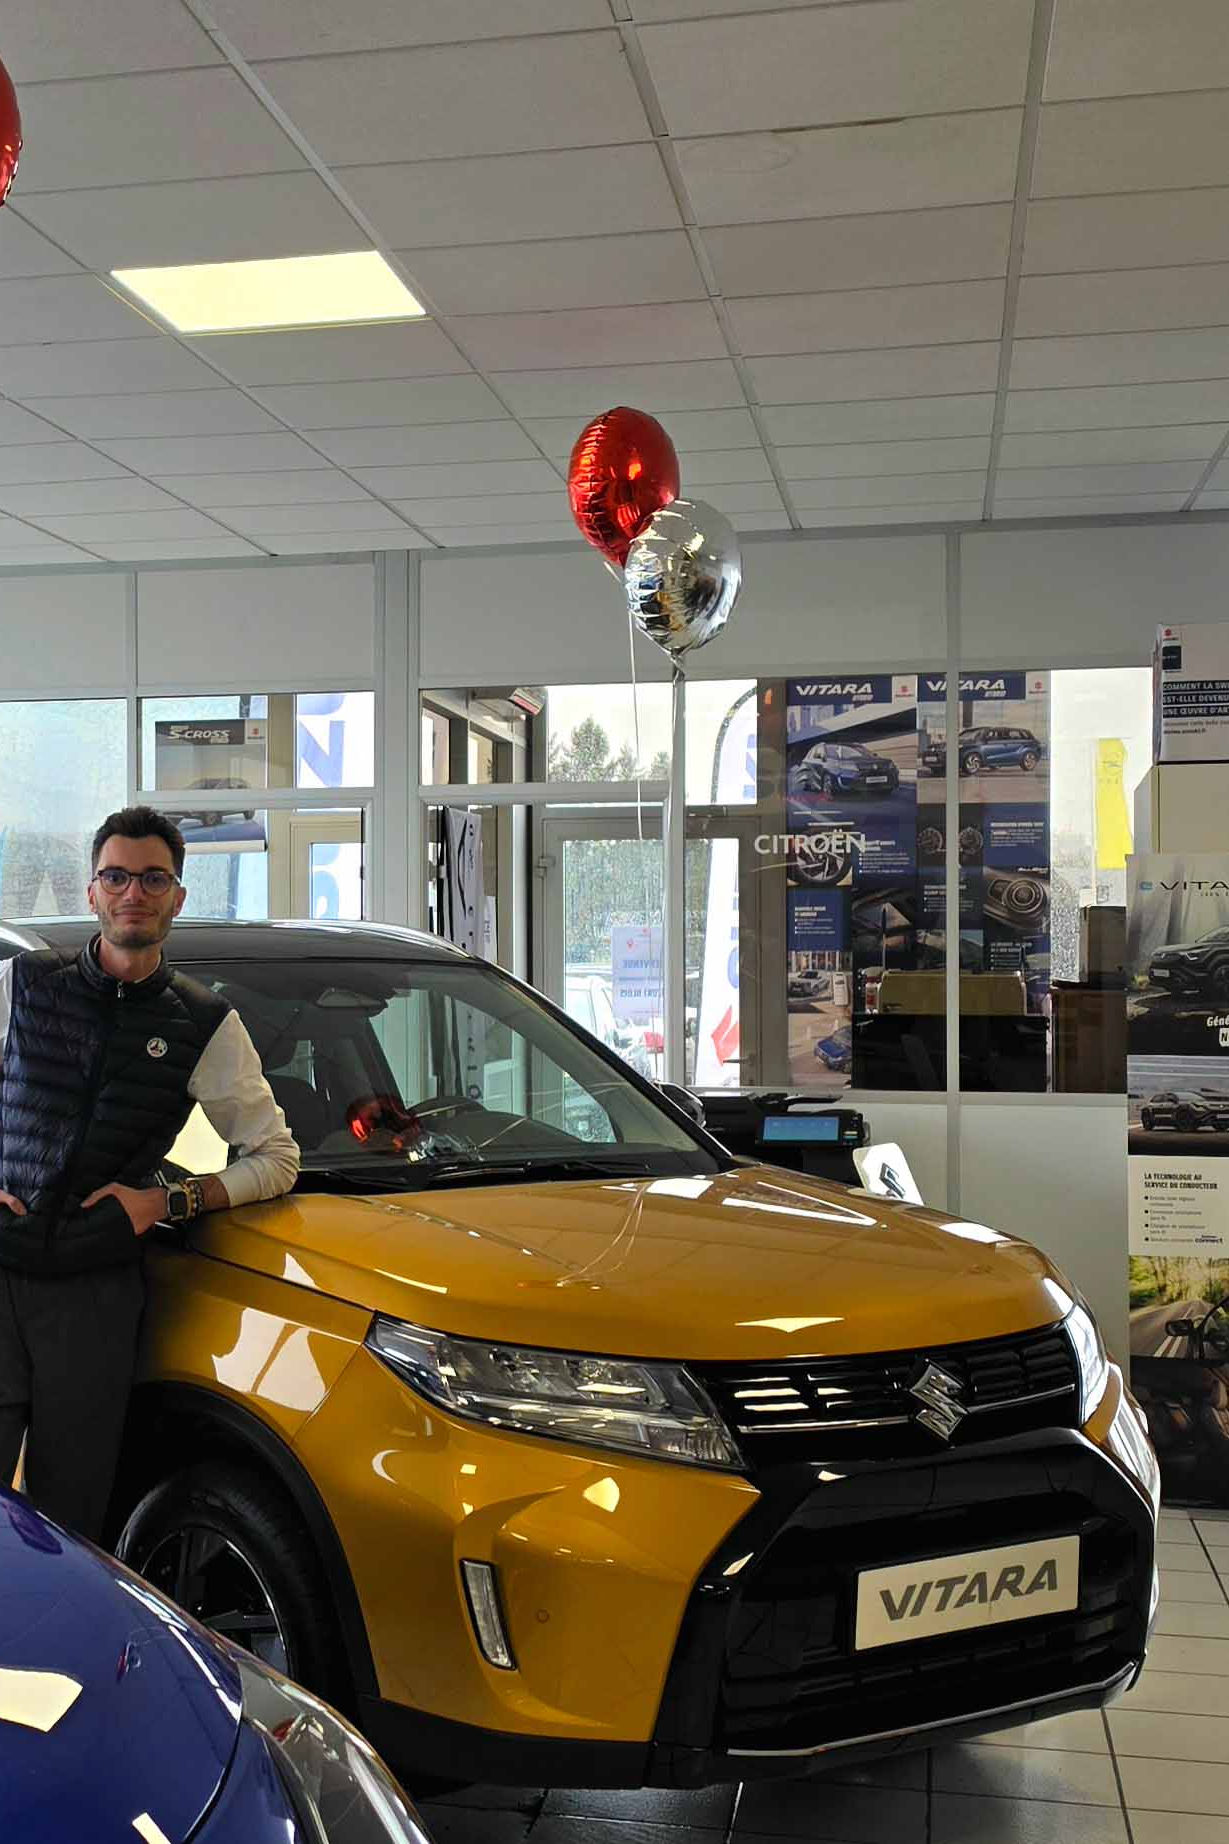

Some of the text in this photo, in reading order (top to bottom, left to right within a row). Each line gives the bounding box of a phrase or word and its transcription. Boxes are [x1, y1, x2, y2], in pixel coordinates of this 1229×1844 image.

[795, 682, 873, 696] VITARA
[926, 679, 1006, 692] VIARA
[754, 829, 866, 854] CITROËN
[1144, 1172, 1202, 1181] LA TECHNOLOGIE AU
[1144, 1181, 1168, 1189] SERVICE
[1179, 1182, 1217, 1190] CONDUCTEUR
[879, 1558, 1058, 1622] VITARA
